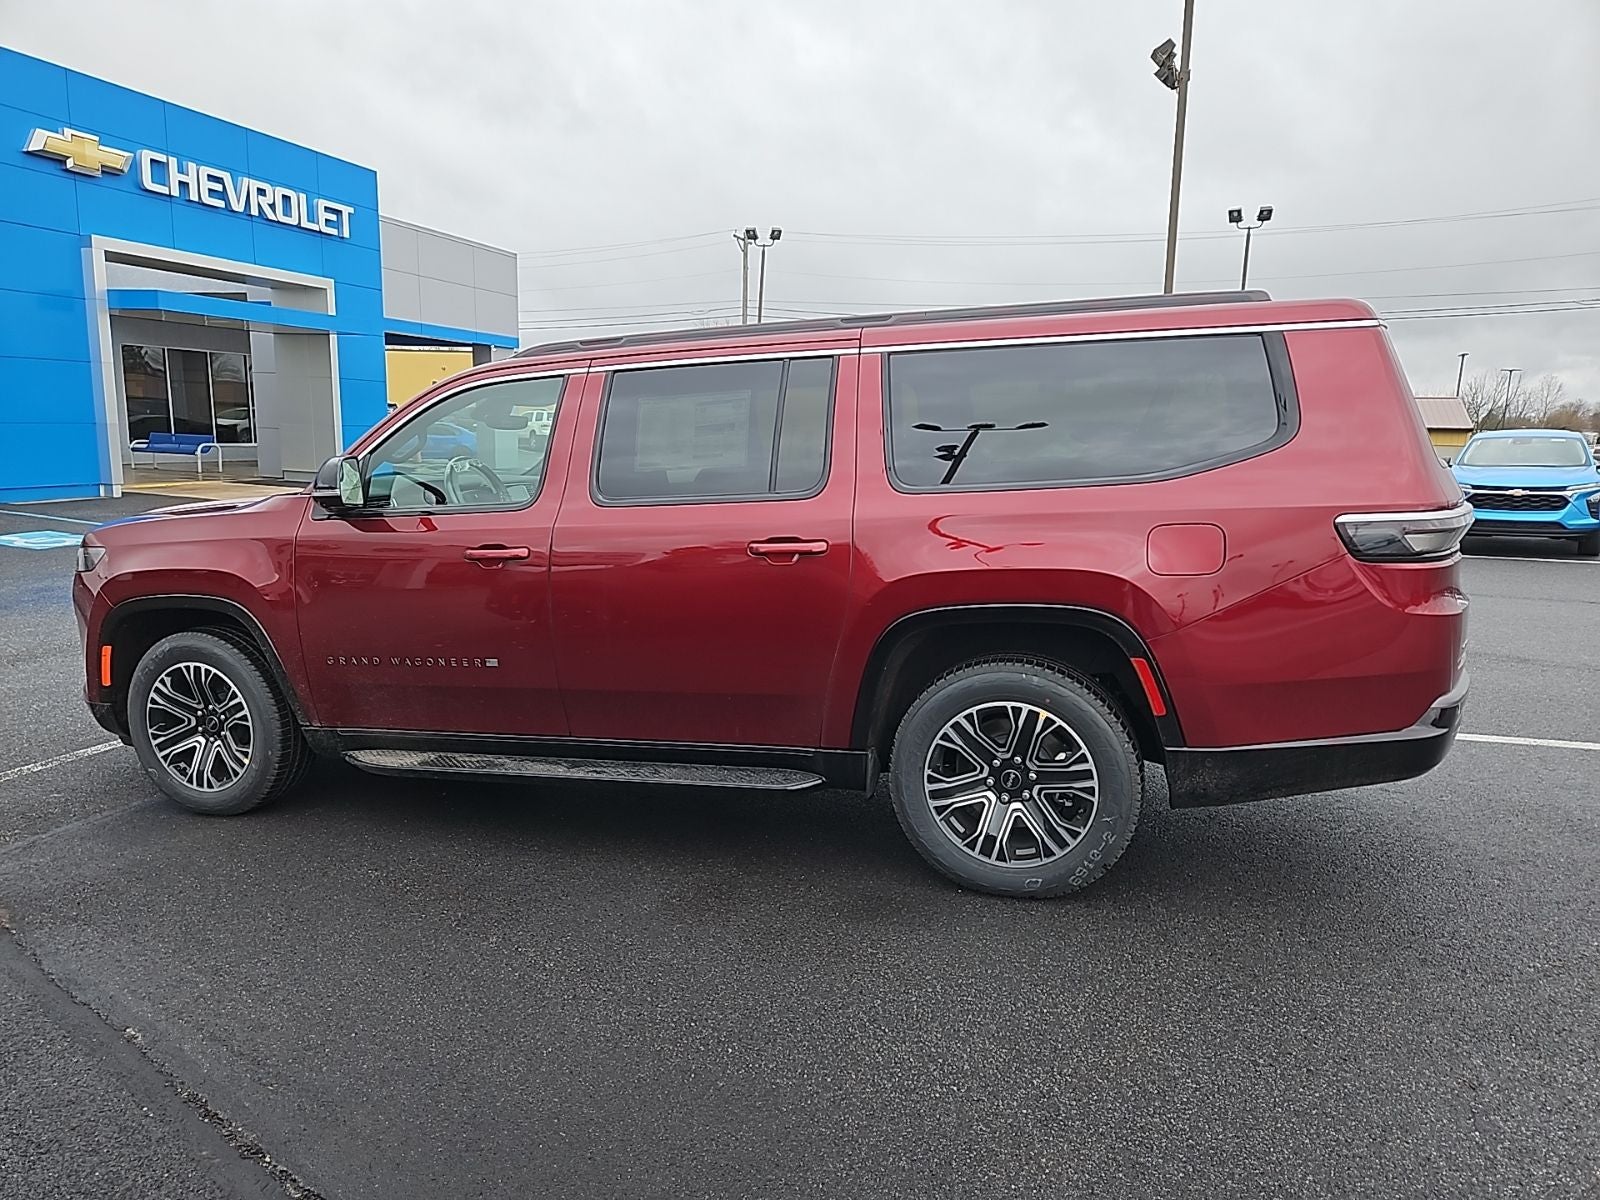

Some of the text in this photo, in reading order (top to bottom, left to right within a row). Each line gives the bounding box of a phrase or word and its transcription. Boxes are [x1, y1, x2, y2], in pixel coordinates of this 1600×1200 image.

[138, 149, 355, 238] CHEVROLET
[326, 656, 381, 666] GRAND
[390, 657, 483, 668] WAGONEER
